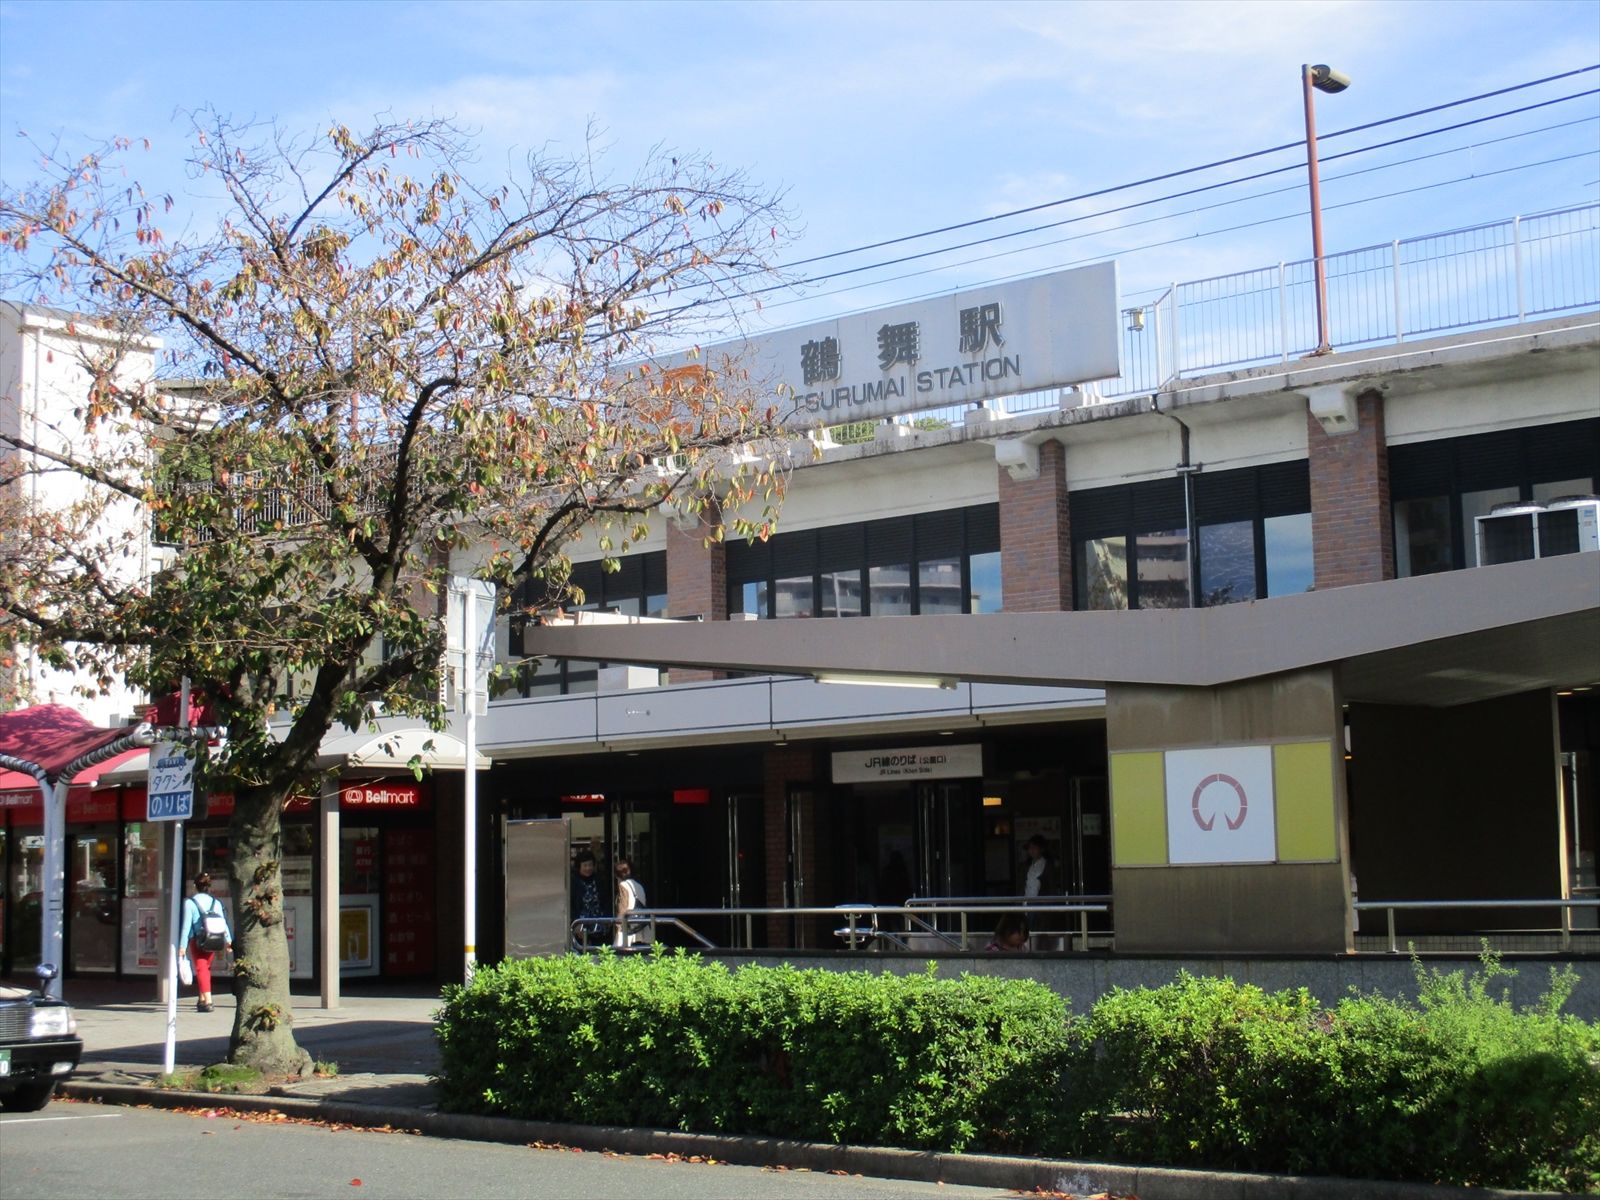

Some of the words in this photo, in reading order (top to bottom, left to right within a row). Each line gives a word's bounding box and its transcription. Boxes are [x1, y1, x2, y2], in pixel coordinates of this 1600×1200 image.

[801, 302, 1005, 386] 鶴舞駅
[794, 376, 905, 413] TSURUMAI
[917, 354, 1021, 393] STATION
[153, 773, 188, 791] タクシ
[151, 794, 189, 815] のりば
[366, 790, 415, 804] Bellmart
